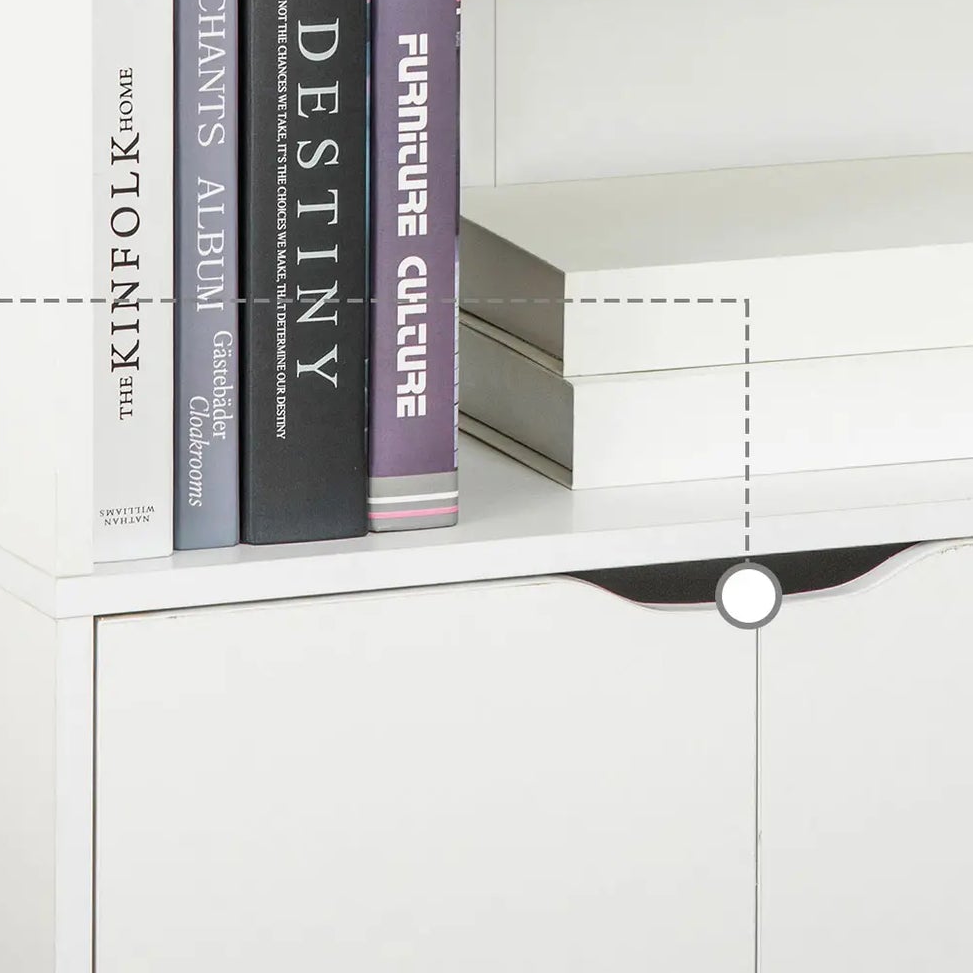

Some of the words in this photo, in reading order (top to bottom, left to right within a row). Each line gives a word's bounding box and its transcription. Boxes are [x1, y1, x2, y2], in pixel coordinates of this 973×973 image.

[277, 0, 288, 22] NOT
[277, 22, 288, 44] THE
[277, 45, 288, 93] CHANCES
[119, 67, 133, 133] HOME
[277, 94, 287, 111] WE
[276, 112, 287, 142] TAKE,
[277, 164, 287, 186] THE
[276, 186, 287, 231] CHOICES
[296, 17, 339, 389] DESTINY
[110, 131, 140, 373] KINFOLK
[196, 176, 226, 313] ALBUM
[276, 231, 287, 248] WE
[275, 249, 287, 283] MAKE,
[276, 312, 286, 371] DETERMINE
[396, 255, 428, 418] CULTURE
[119, 375, 133, 421] THE
[212, 330, 234, 440] Gästebäder
[276, 372, 287, 395] OUR
[275, 396, 287, 440] DESTINY
[189, 395, 211, 507] Cloakrooms
[99, 505, 155, 517] WILLIAMS
[104, 514, 149, 526] NATHAN
